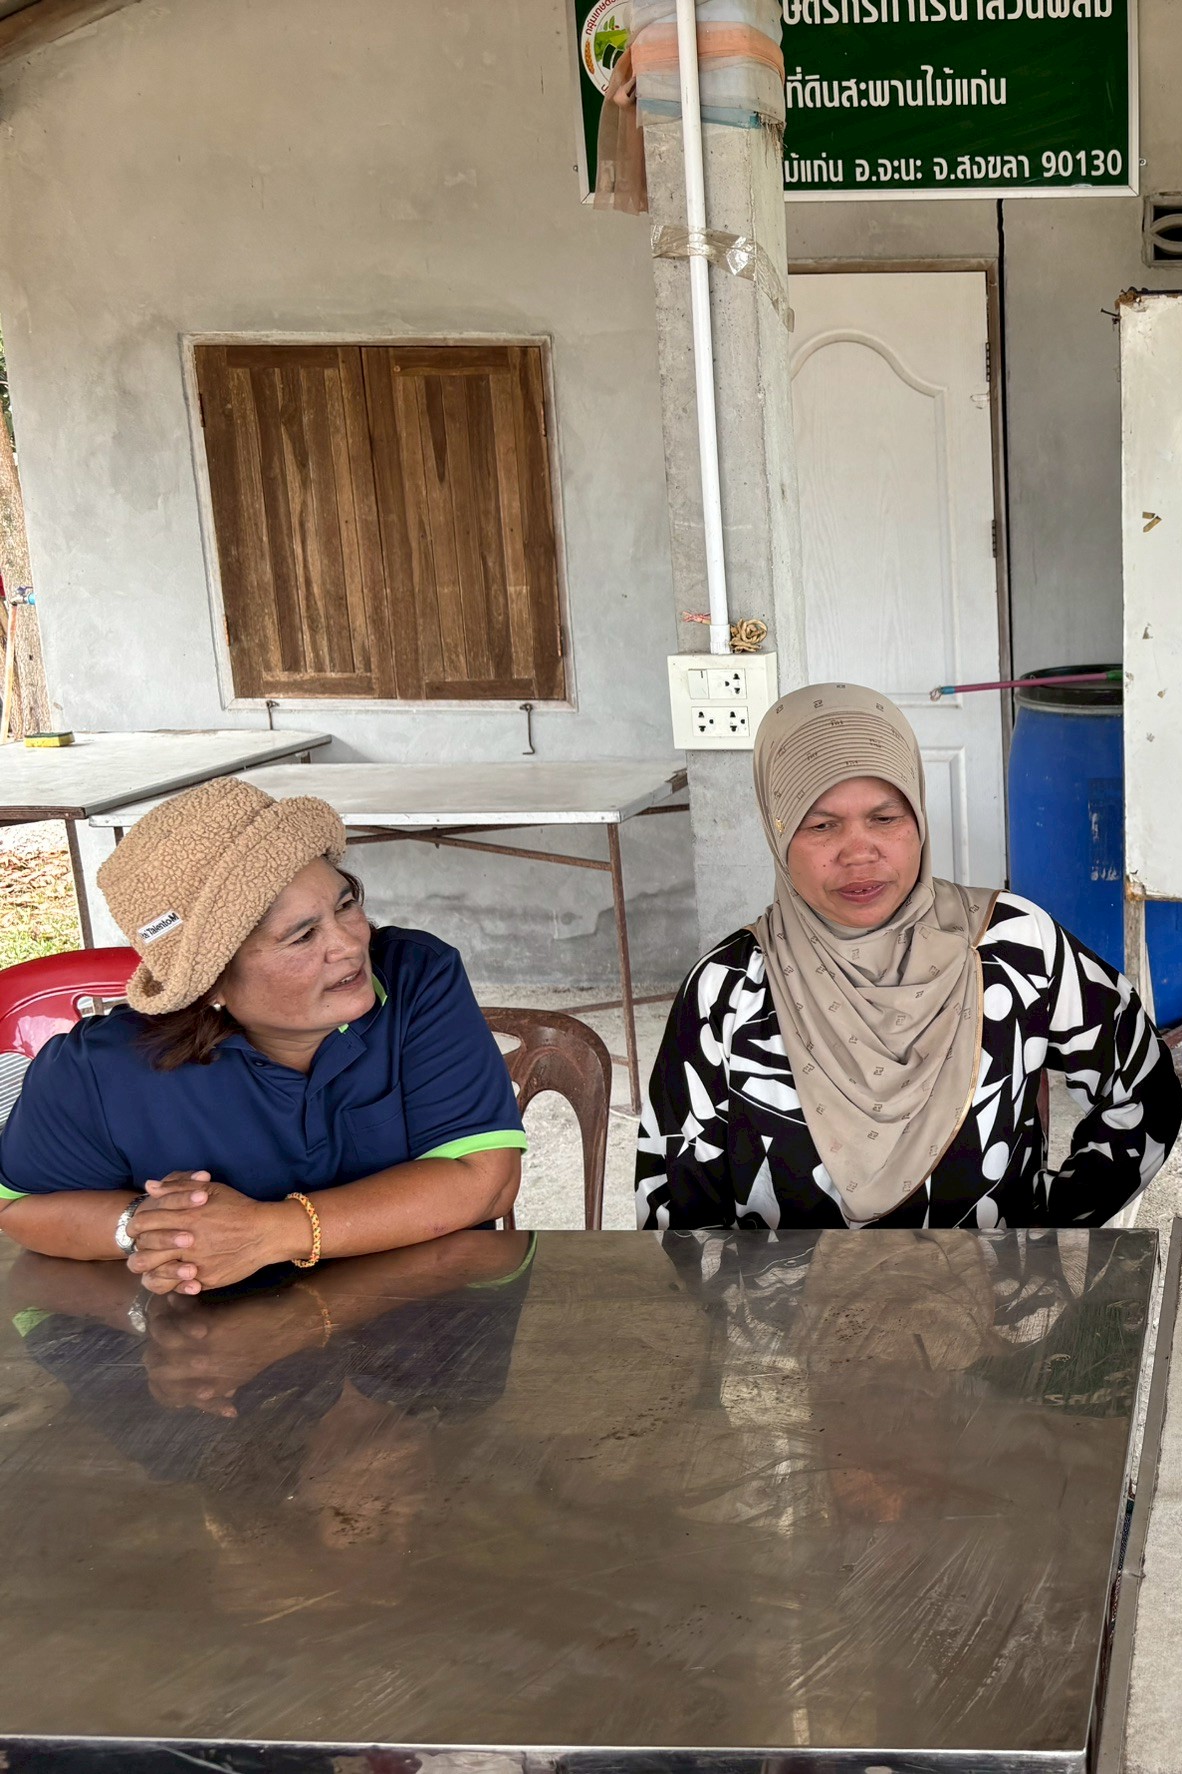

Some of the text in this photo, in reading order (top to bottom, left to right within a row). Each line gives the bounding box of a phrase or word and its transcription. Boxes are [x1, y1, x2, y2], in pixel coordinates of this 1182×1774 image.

[855, 158, 923, 182] อ.จะนะ
[933, 154, 1031, 181] จ.สงขลา
[1041, 149, 1123, 178] 90130
